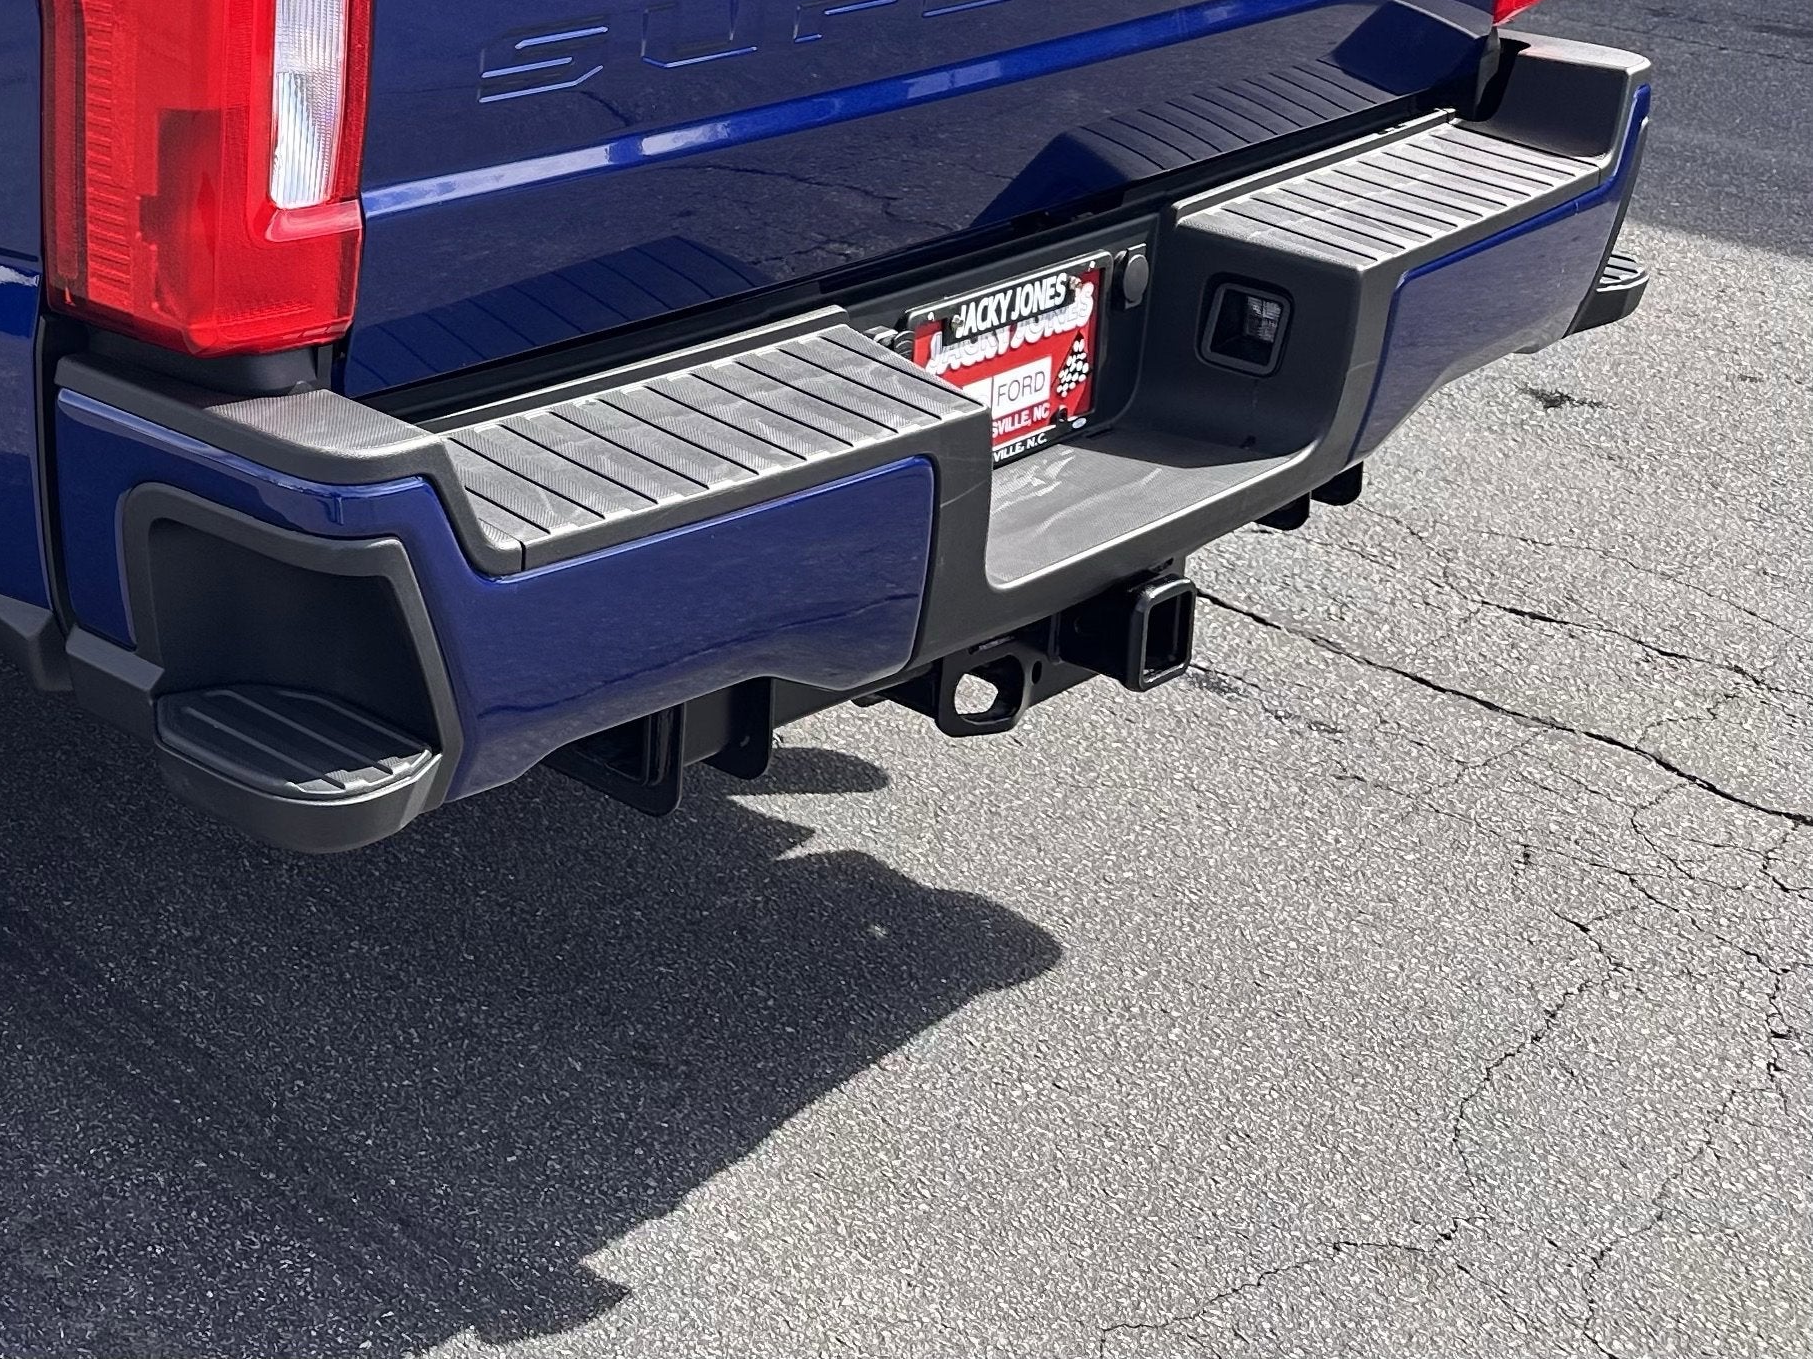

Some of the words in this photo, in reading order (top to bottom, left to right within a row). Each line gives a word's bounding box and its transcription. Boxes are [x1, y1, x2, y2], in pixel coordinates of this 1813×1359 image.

[955, 289, 1012, 339] JACKY
[1011, 272, 1067, 321] JONES
[997, 370, 1046, 407] FORD
[992, 409, 1032, 438] SVILLE,
[1032, 402, 1051, 422] NC
[993, 441, 1024, 463] VILLE,
